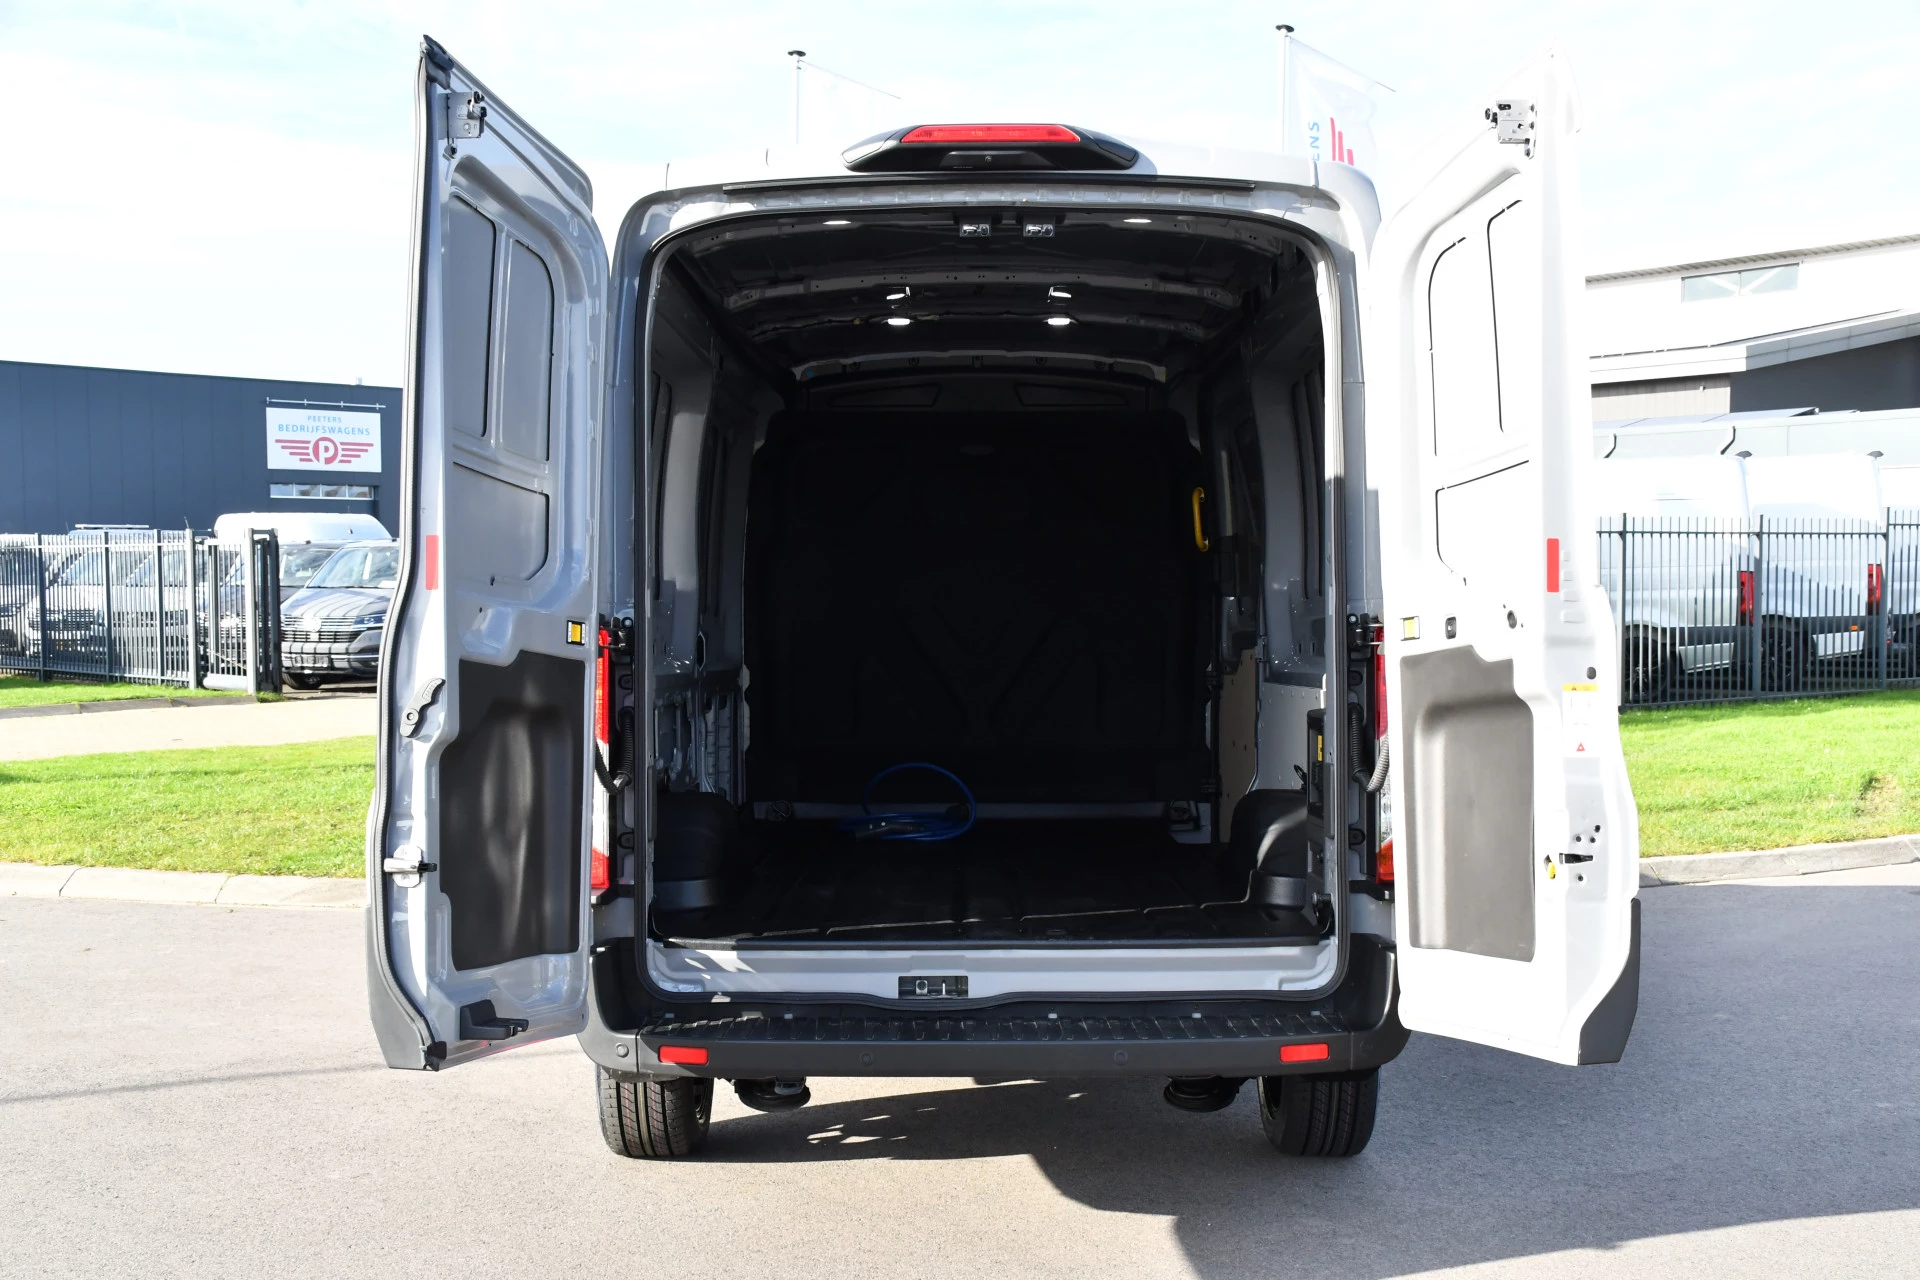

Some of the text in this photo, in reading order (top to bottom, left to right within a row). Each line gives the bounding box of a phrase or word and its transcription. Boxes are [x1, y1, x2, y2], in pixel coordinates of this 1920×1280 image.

[307, 415, 342, 423] PEETERS
[278, 423, 370, 436] BEDRIJFSWAGENS
[316, 439, 336, 464] P
